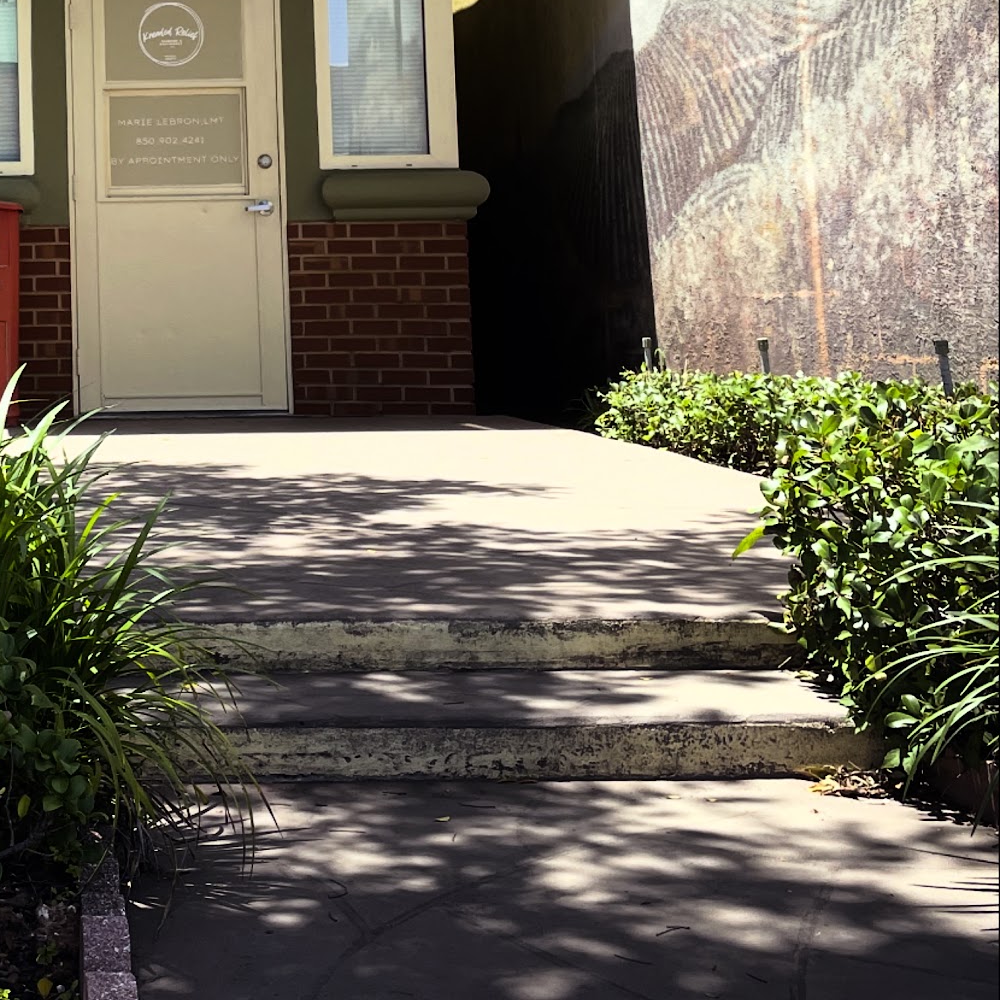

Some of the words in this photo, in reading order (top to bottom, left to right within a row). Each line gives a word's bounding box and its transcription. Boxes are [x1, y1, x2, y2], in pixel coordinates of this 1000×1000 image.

[117, 117, 153, 127] MARIE
[111, 157, 124, 166] BY
[210, 154, 240, 164] ONLY
